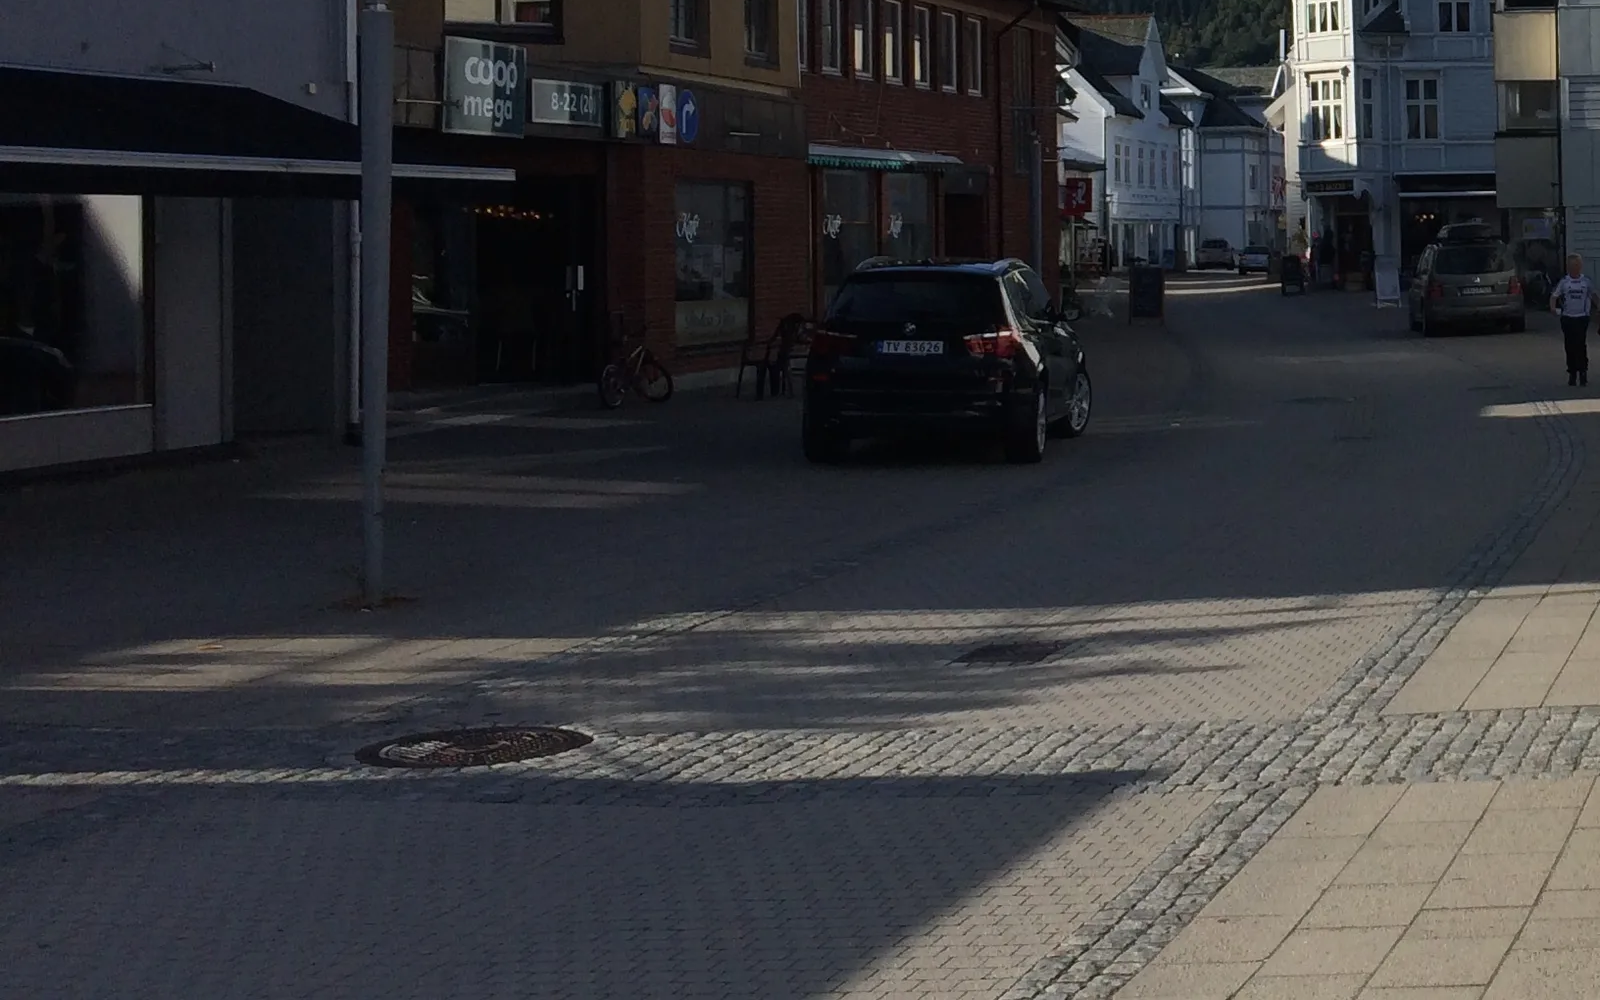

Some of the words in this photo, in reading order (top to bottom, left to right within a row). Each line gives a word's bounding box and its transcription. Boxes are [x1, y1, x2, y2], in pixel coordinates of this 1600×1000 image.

[464, 56, 518, 95] coop
[463, 95, 513, 127] mega
[551, 92, 577, 111] 8-22
[886, 342, 900, 352] TV
